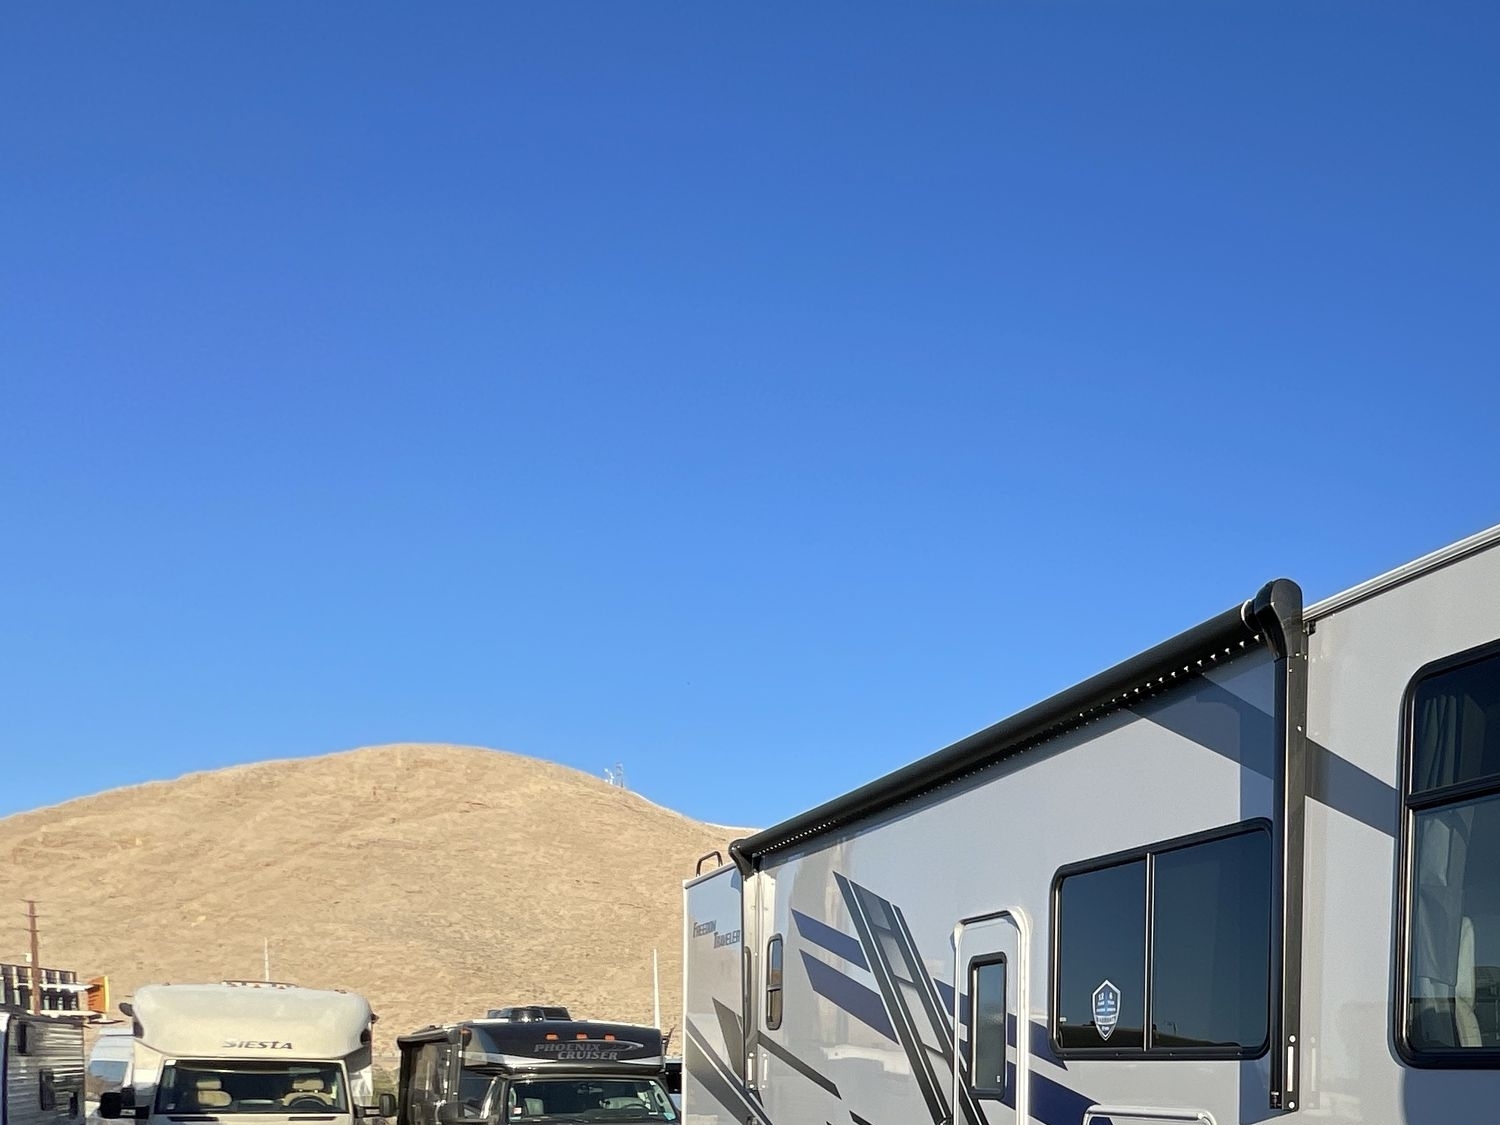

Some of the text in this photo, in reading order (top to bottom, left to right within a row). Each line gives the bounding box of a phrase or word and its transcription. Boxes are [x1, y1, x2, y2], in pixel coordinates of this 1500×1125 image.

[221, 1040, 293, 1049] SIESTA
[533, 1043, 601, 1053] PHOENIX
[557, 1050, 619, 1060] CRUISER
